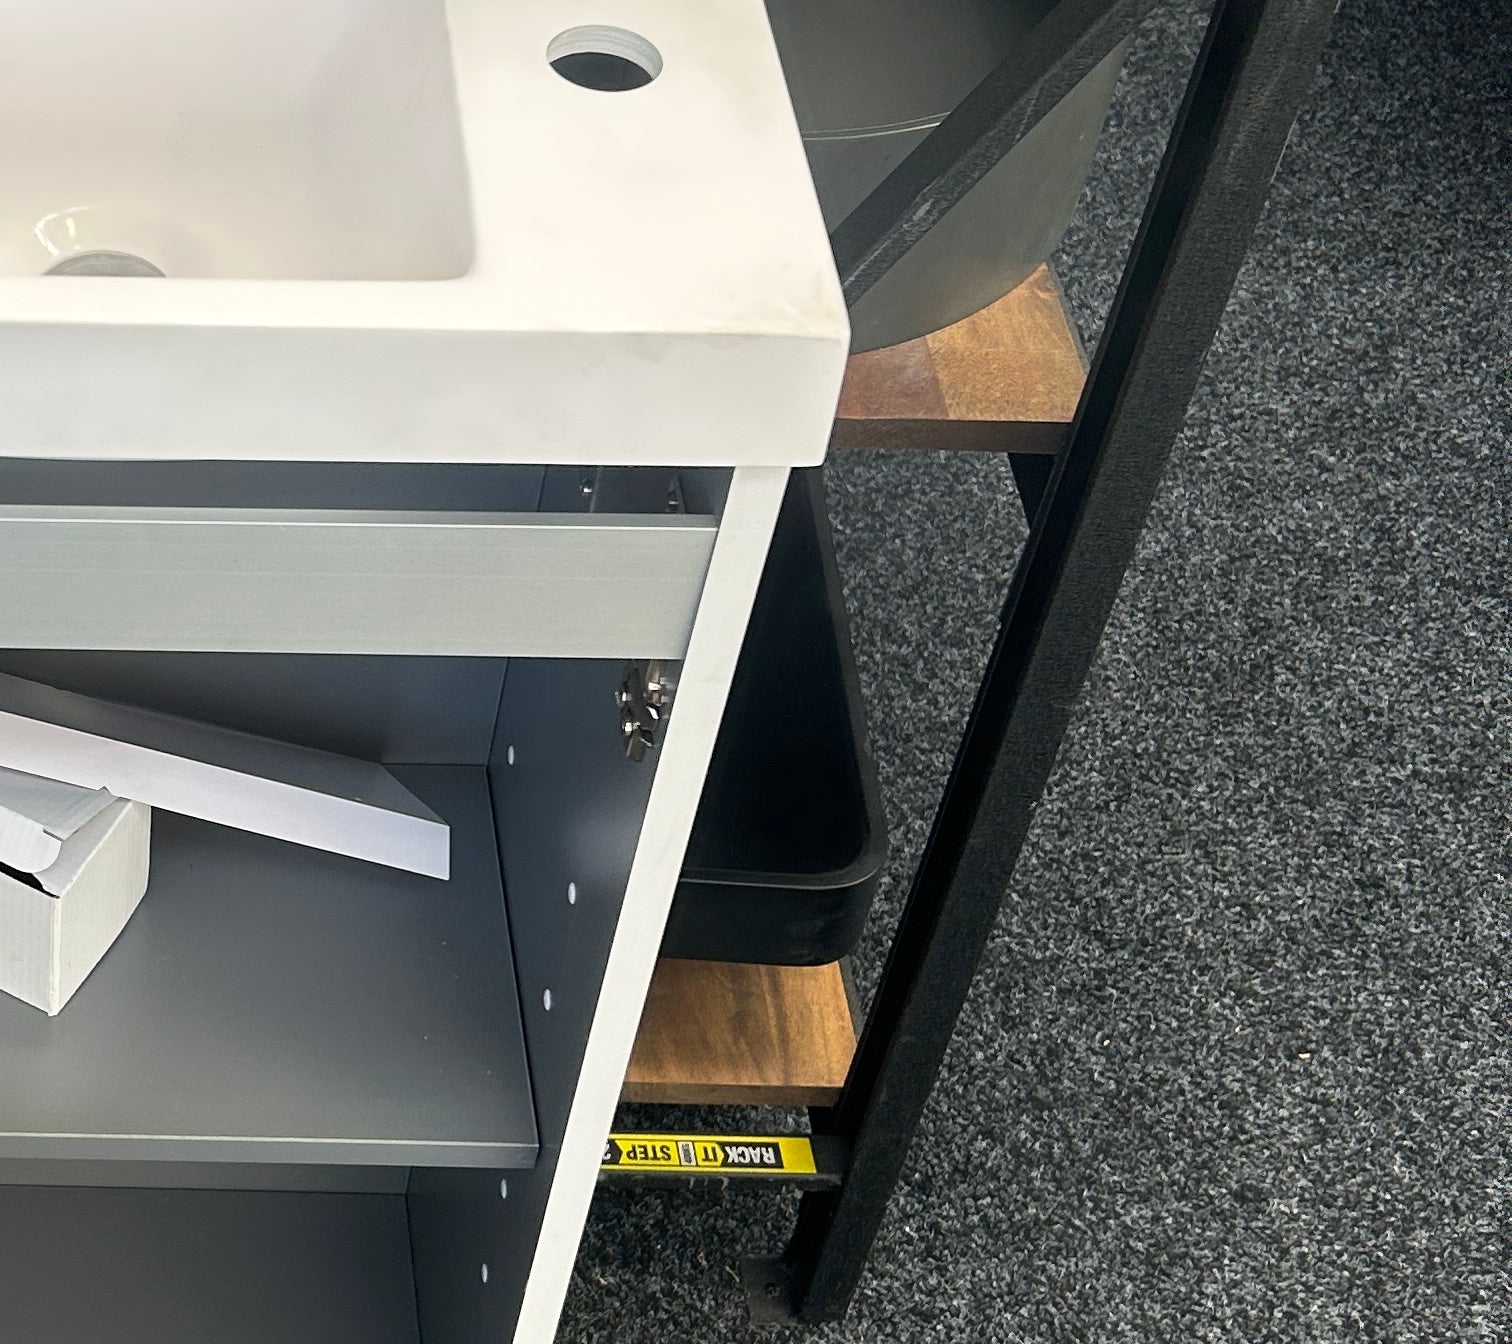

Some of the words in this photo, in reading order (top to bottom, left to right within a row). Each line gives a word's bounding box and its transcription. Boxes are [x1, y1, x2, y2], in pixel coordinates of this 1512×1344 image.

[626, 1144, 671, 1161] STEP
[701, 1146, 718, 1163] IT
[724, 1146, 776, 1164] RACK
